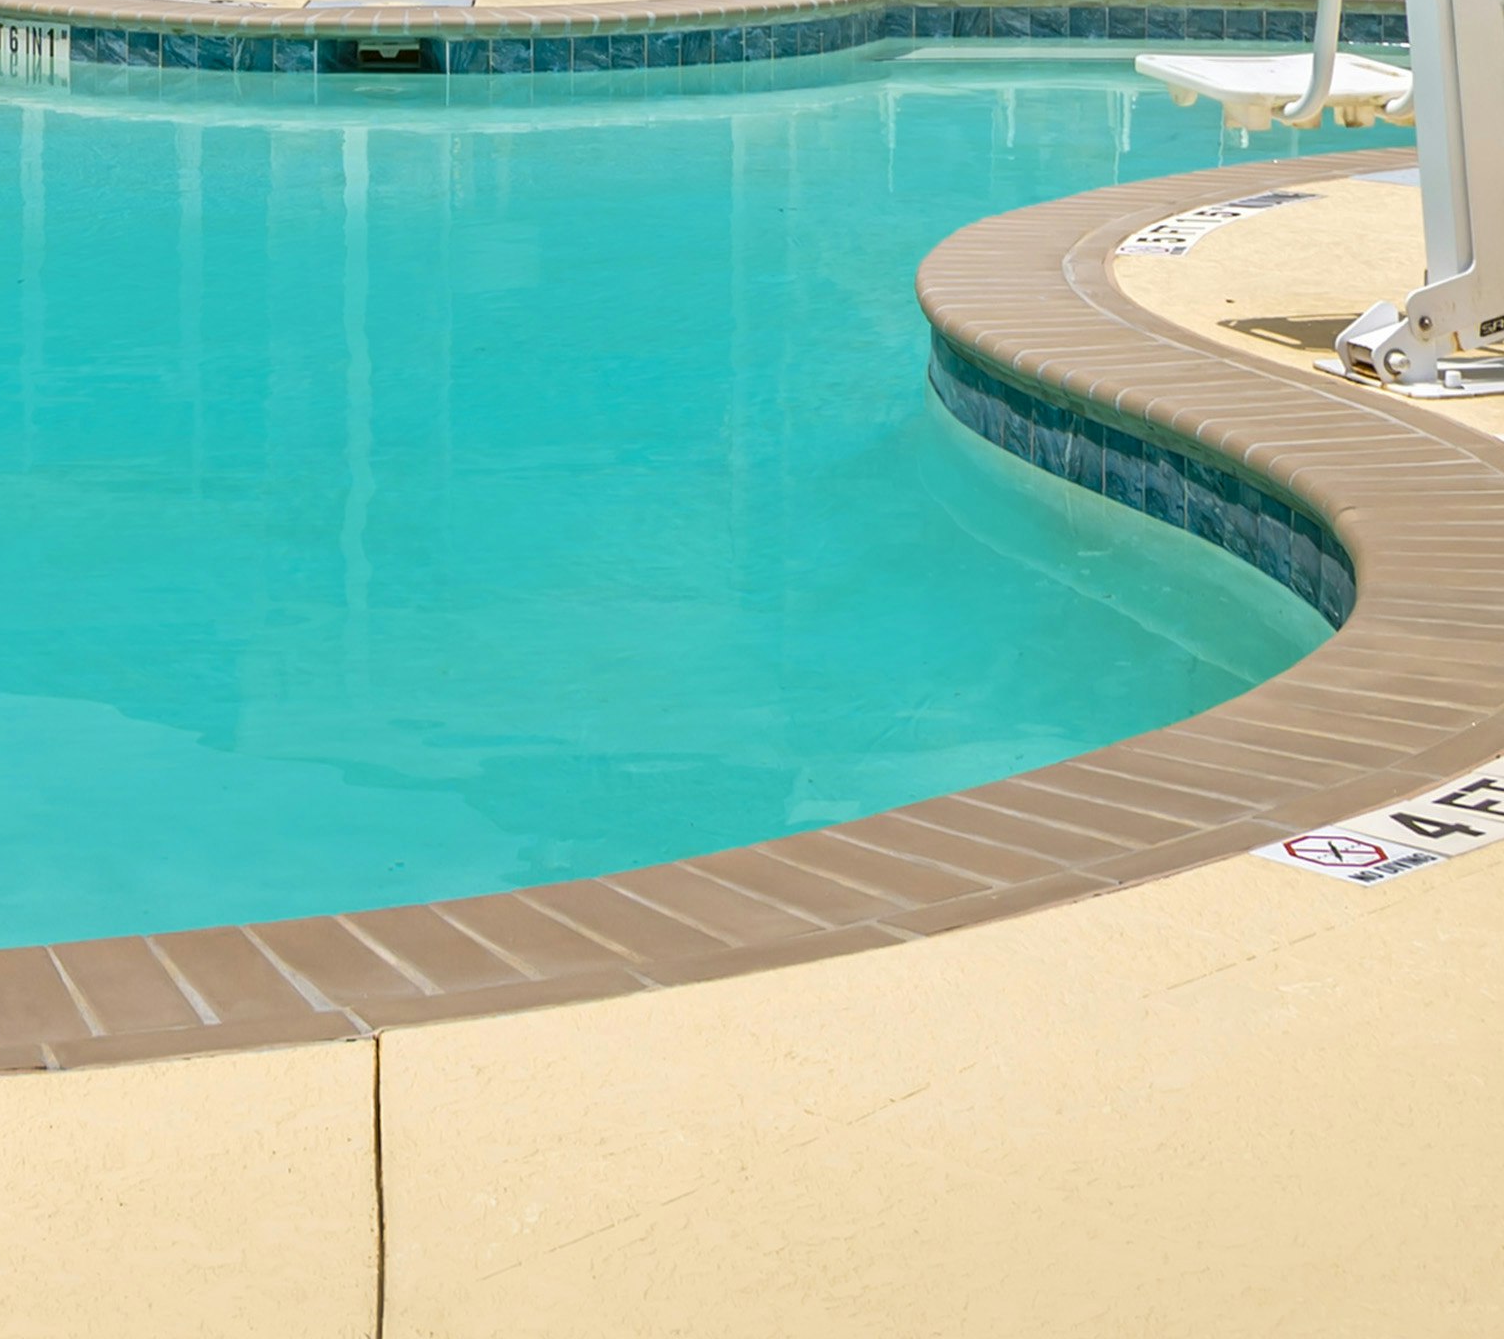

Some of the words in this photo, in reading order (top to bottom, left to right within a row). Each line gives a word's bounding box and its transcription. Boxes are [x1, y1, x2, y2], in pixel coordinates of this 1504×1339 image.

[9, 26, 18, 53] 6
[26, 26, 42, 56] IN
[1388, 812, 1486, 839] 4
